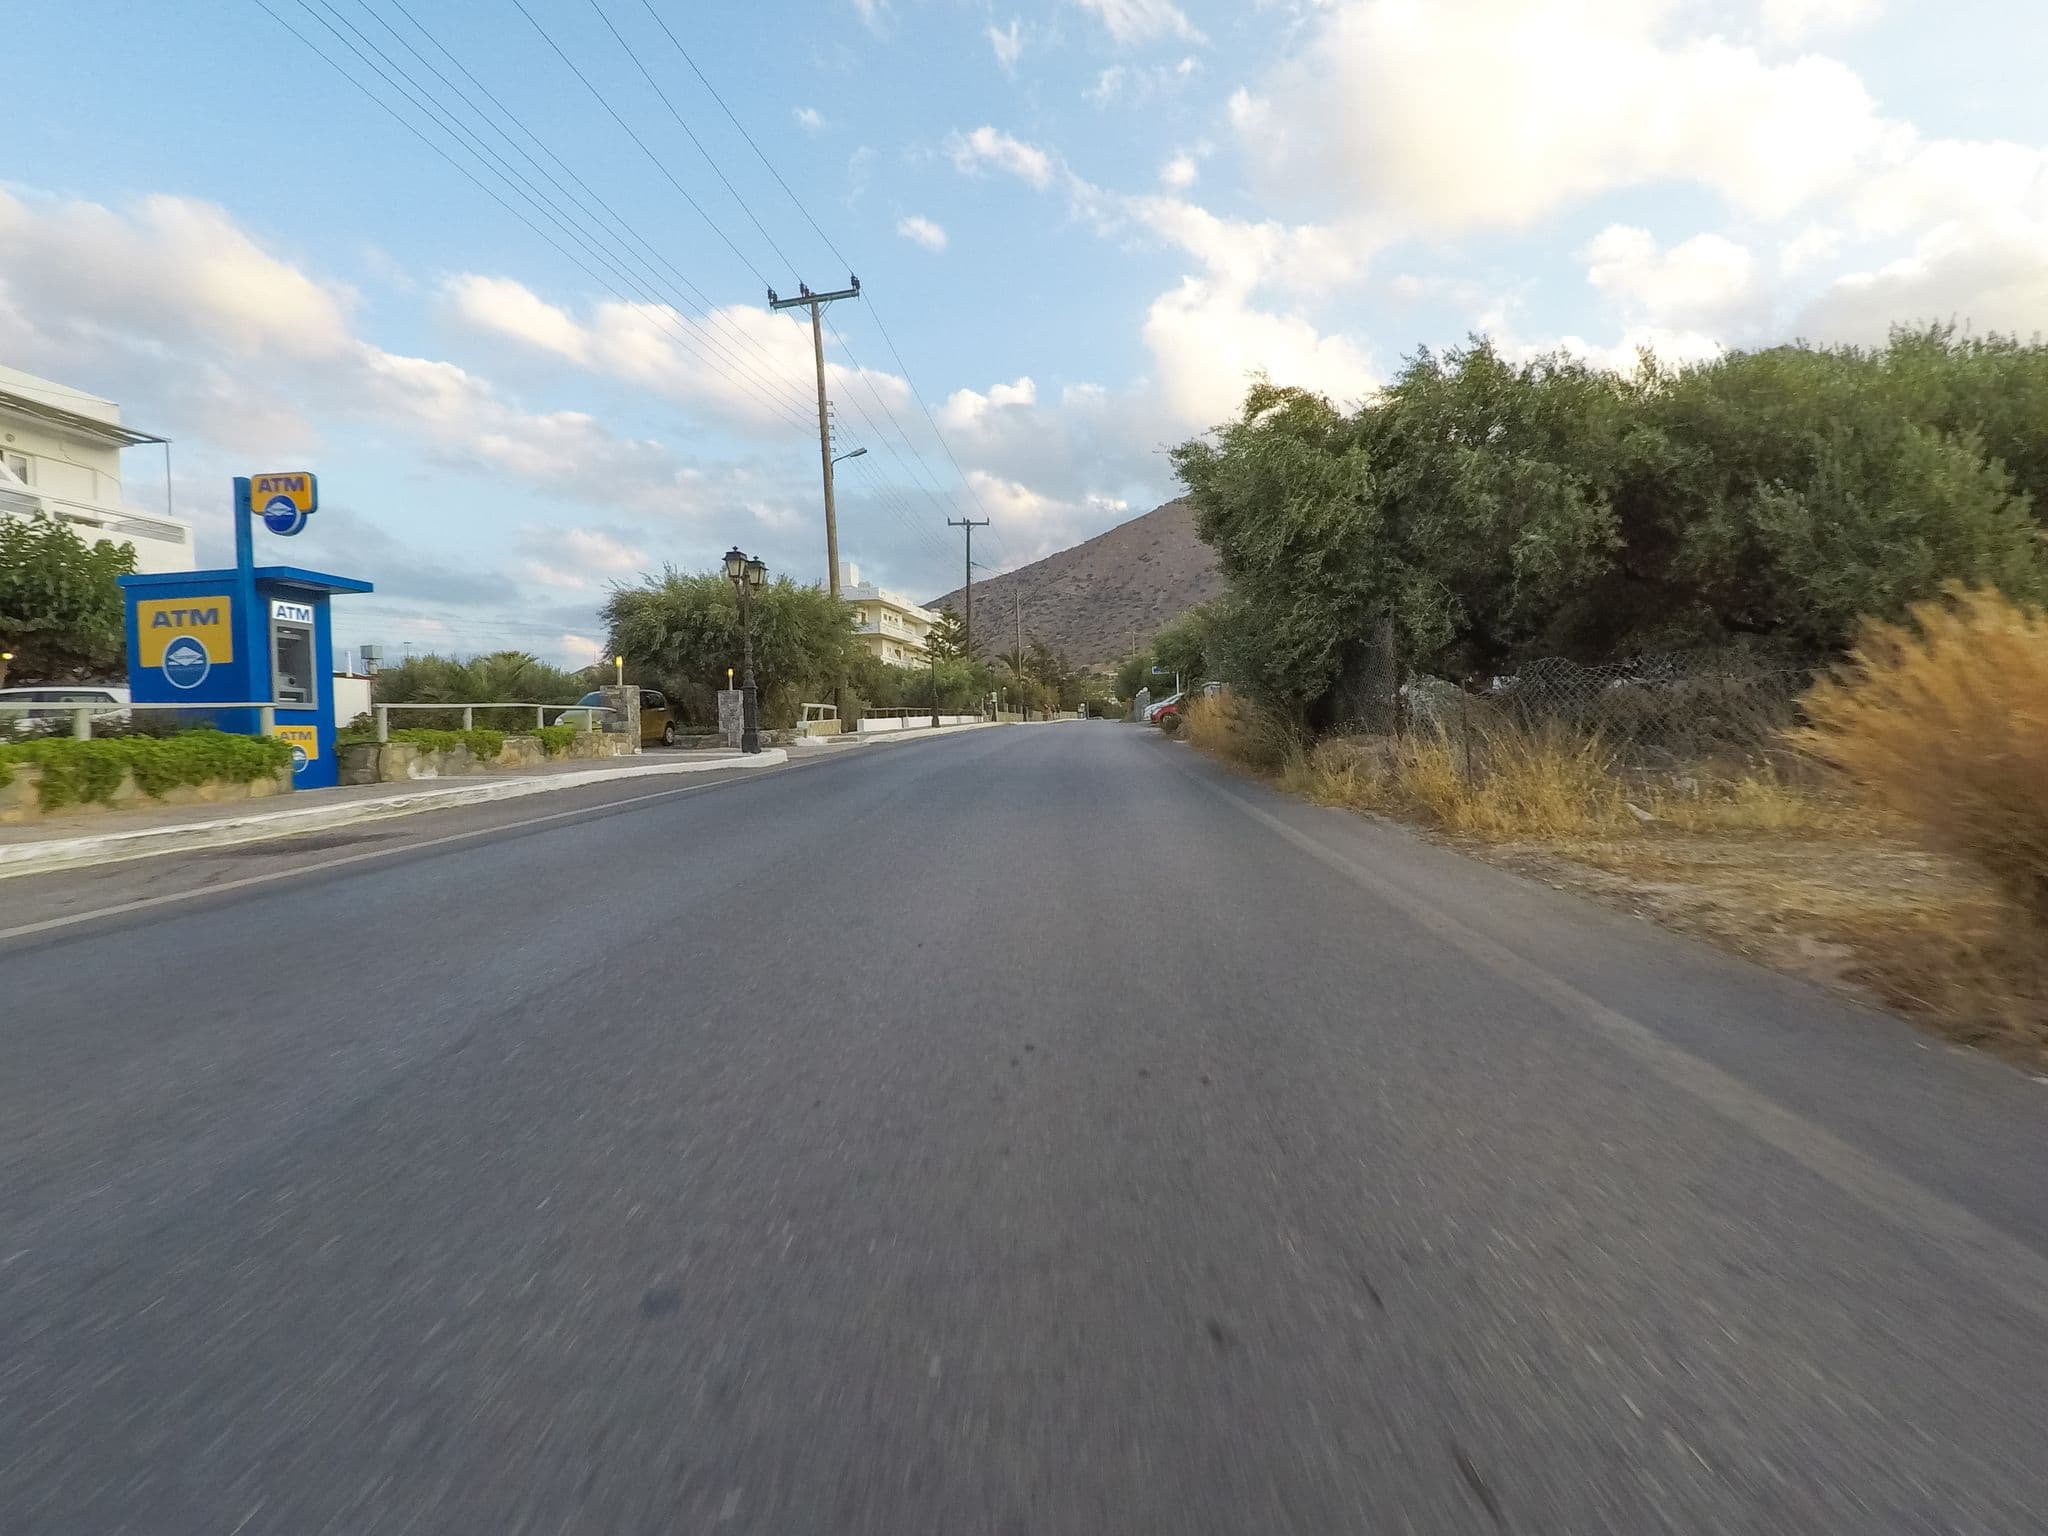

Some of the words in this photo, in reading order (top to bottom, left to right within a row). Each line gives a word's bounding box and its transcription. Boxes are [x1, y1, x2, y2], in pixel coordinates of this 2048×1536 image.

[258, 477, 305, 492] ATM
[152, 608, 219, 628] ATM
[276, 605, 310, 621] ATM
[280, 731, 312, 741] ATM
